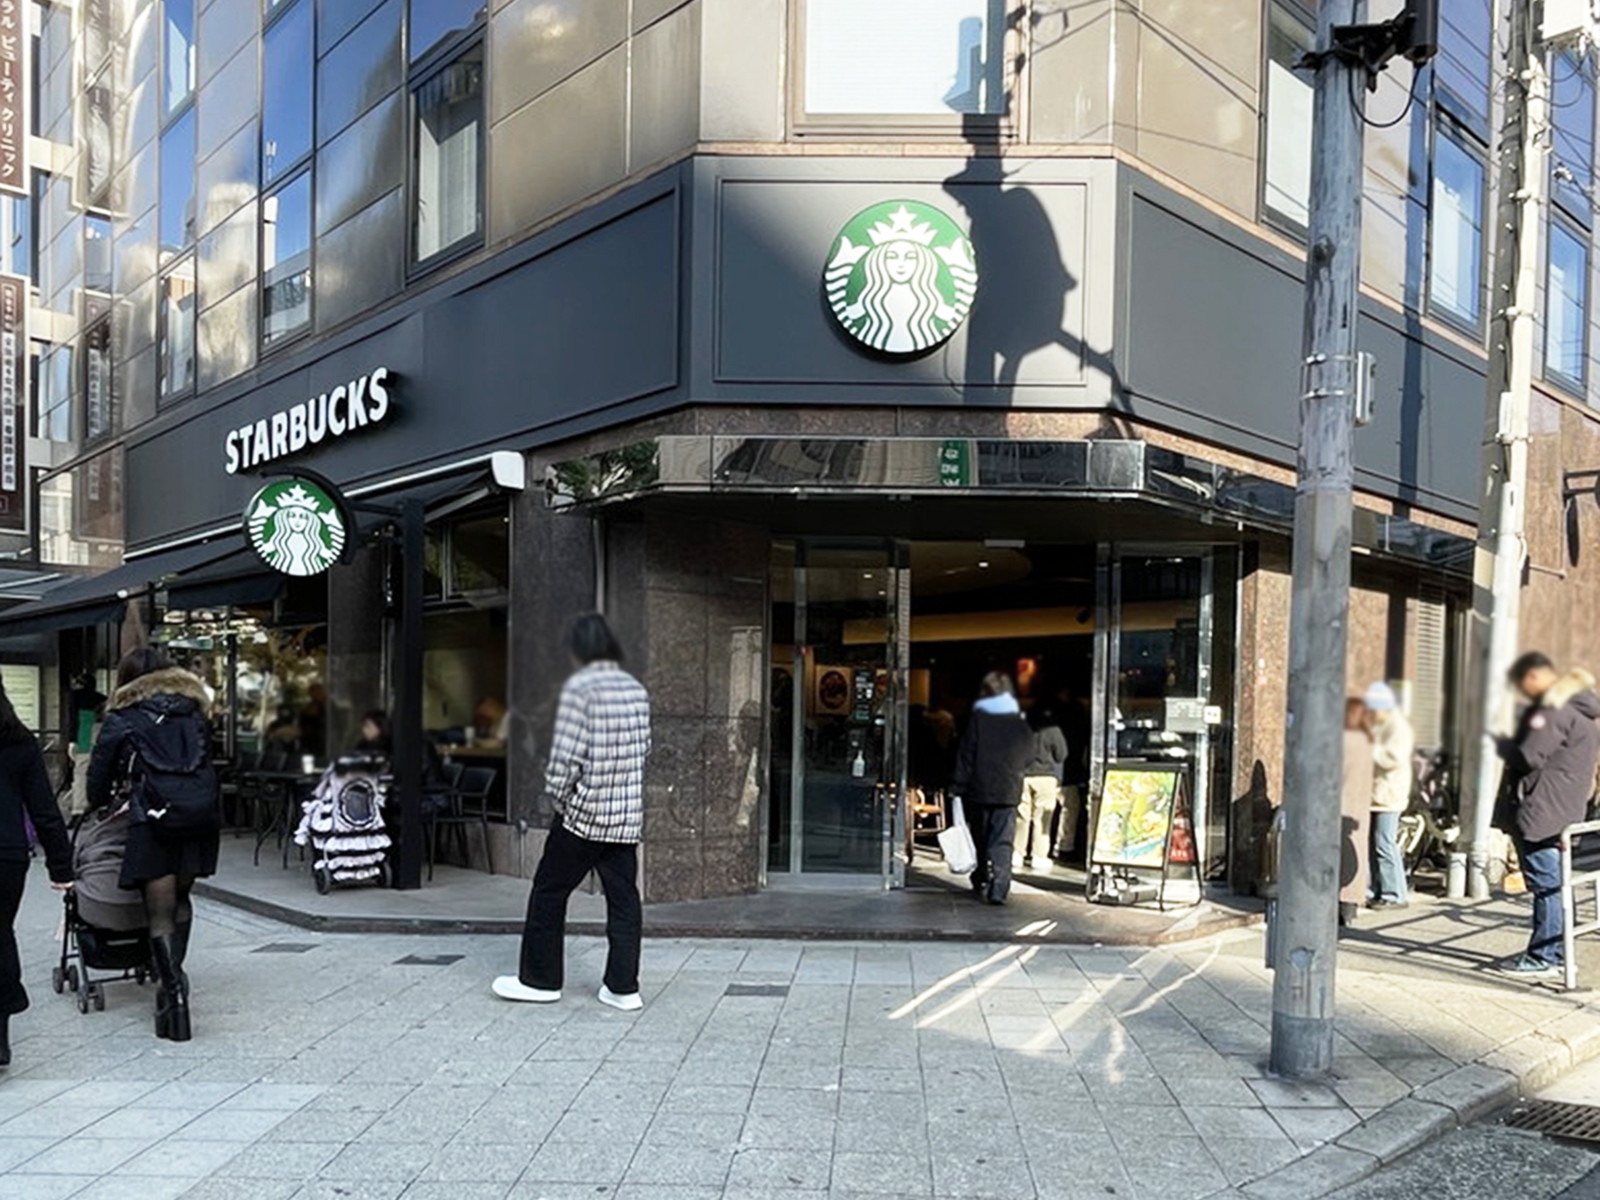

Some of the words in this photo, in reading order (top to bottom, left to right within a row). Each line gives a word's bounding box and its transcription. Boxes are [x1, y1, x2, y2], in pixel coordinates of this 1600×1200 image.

[0, 107, 16, 177] クリニック
[225, 367, 389, 475] STARBUCKS
